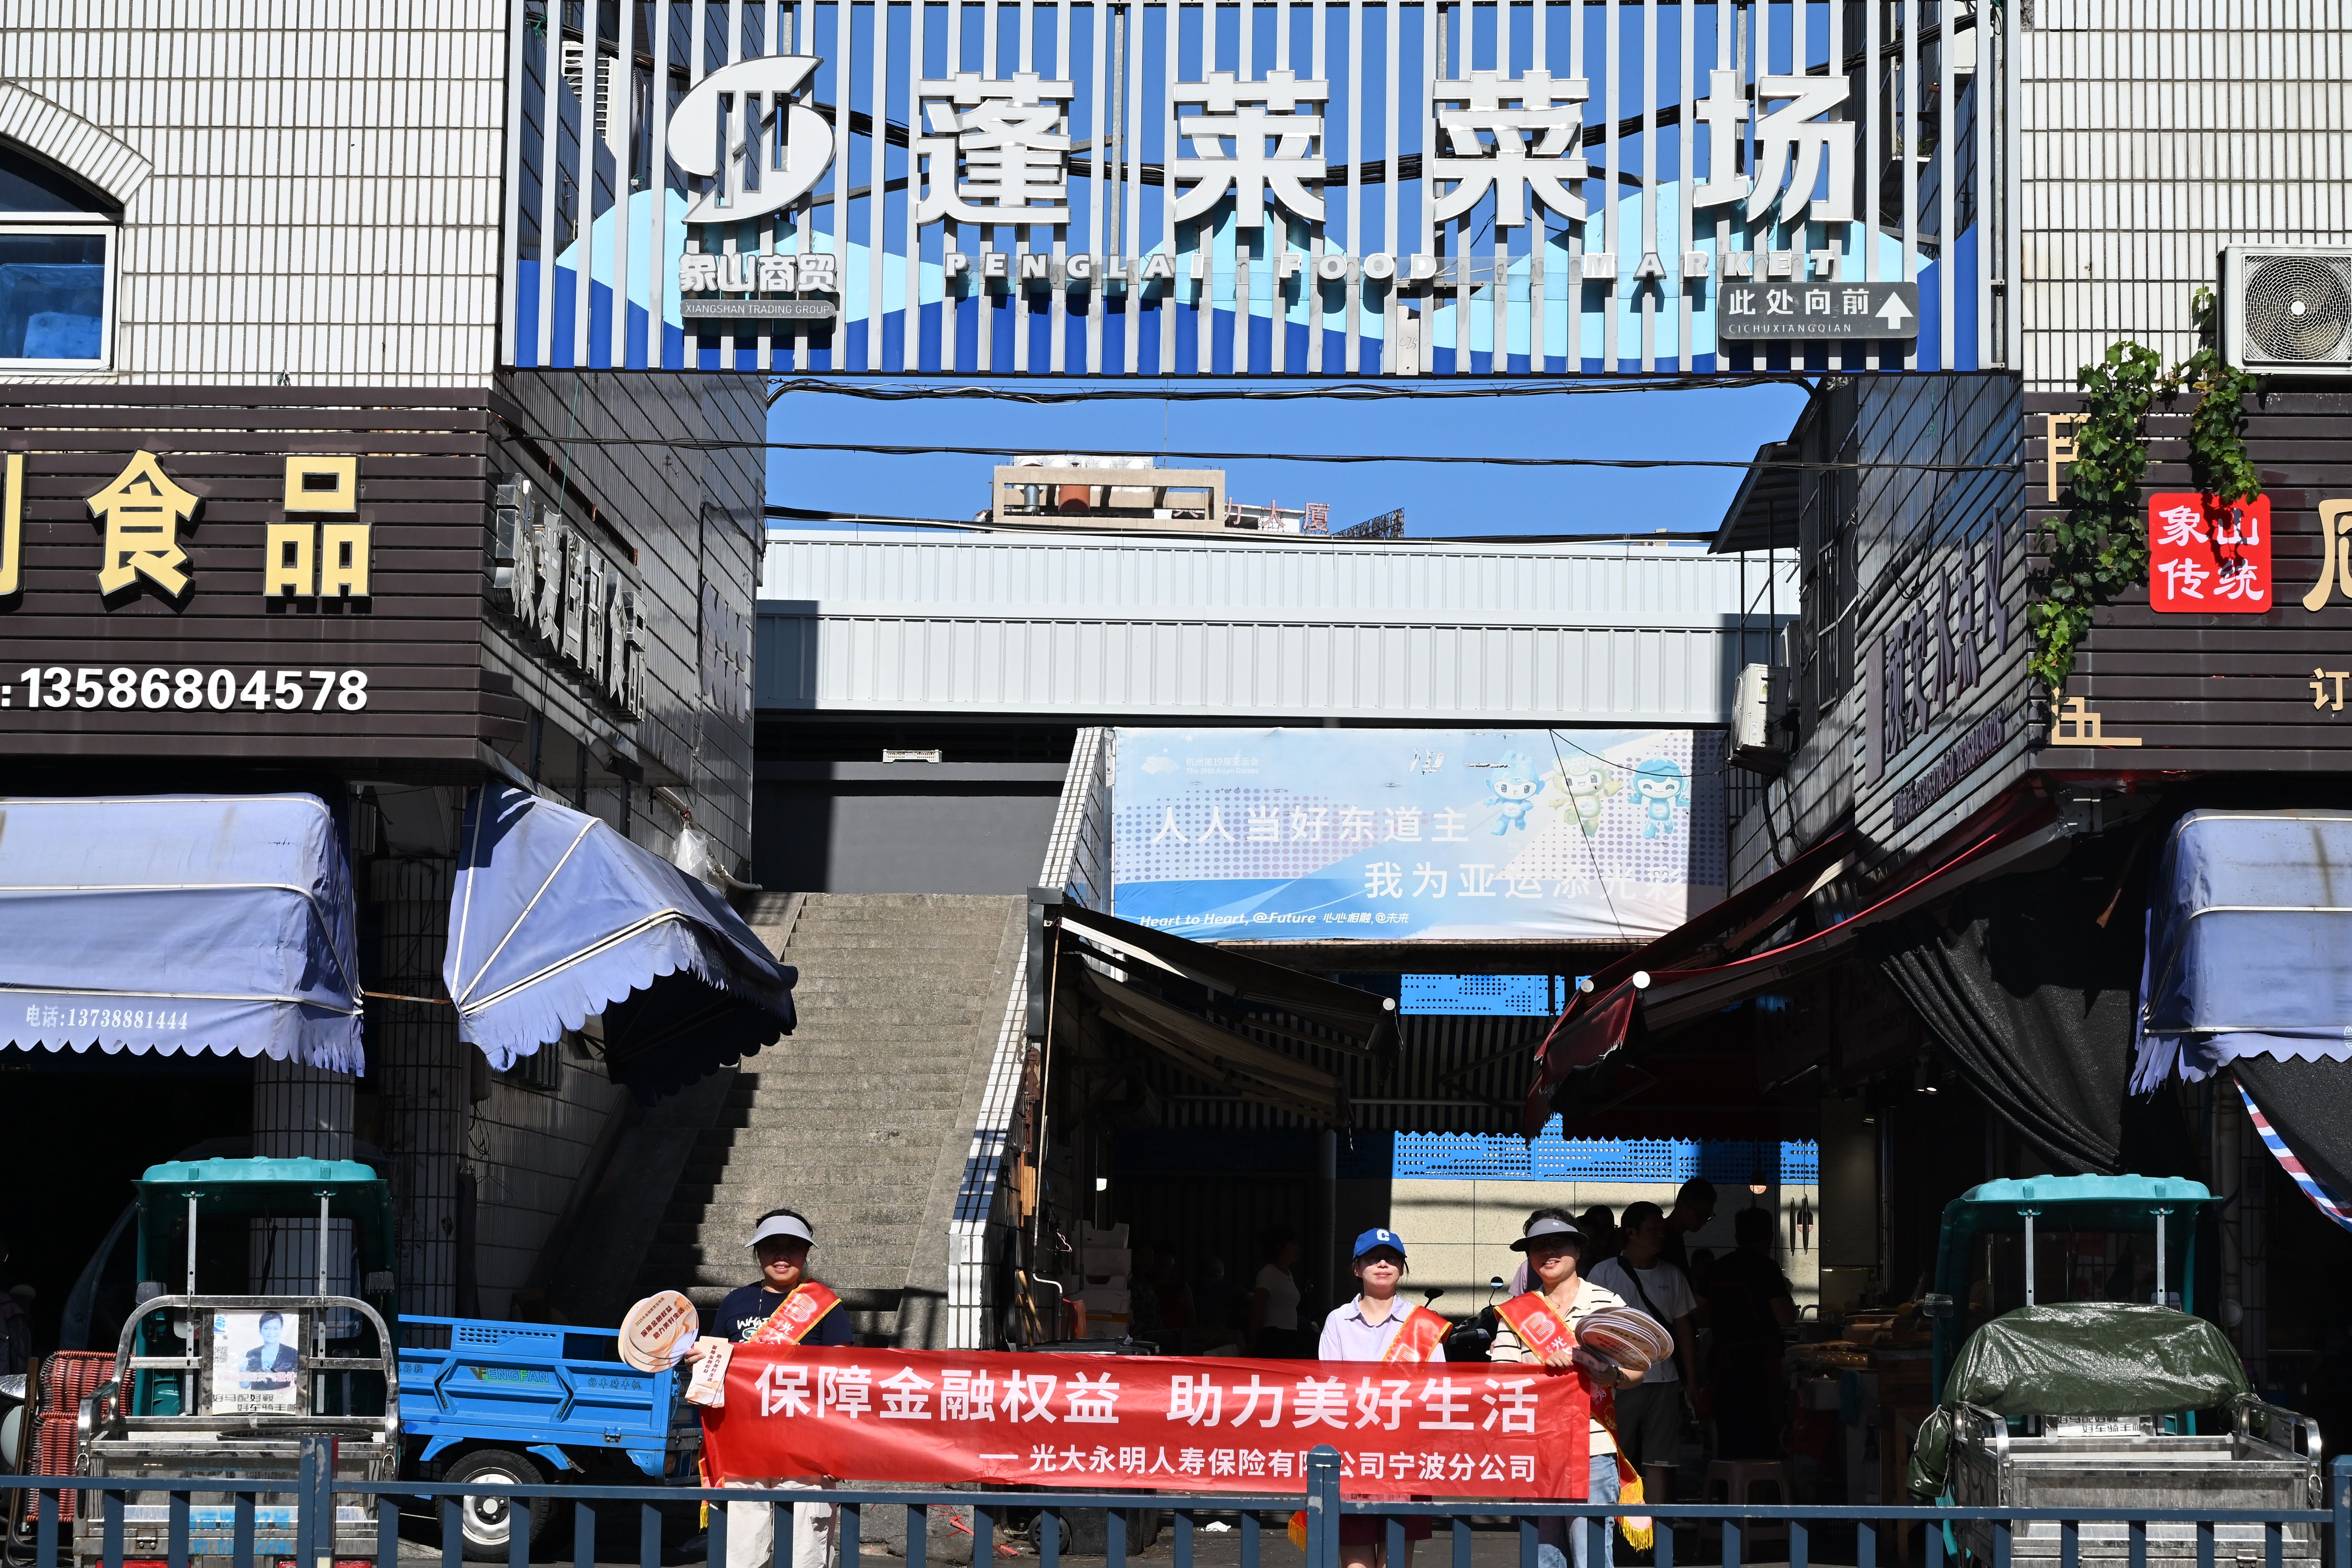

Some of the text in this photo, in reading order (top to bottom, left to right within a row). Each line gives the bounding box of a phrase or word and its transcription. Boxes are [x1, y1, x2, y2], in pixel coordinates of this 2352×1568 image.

[917, 70, 1855, 228] 蓬莱菜场
[679, 253, 837, 294] 象山商贸
[945, 250, 1835, 281] PENGLAI FOOD MARKET
[686, 304, 830, 314] XIANGSHAN TRADING GROUP
[1729, 288, 1869, 316] 此处向前
[1729, 324, 1852, 334] CICHUXIANGQIAN
[0, 447, 372, 599] 食品
[2158, 504, 2260, 546] 象山
[2158, 558, 2264, 600] 传统
[2310, 668, 2349, 710] 订
[1186, 758, 1258, 766] 杭州第19届亚运会
[1151, 805, 1469, 844] 人人当好东道主
[1364, 861, 1684, 903] 我为亚运添光彩
[1140, 915, 1180, 927] Heart
[1186, 915, 1200, 925] to
[1204, 913, 1249, 926] Heart,
[1253, 912, 1316, 924] @Future
[26, 1004, 188, 1030] 电话:13738881444
[1376, 1229, 1390, 1241] C
[213, 1393, 274, 1402] 好马配好鞍
[754, 1363, 1537, 1433] 保障金融权益 助力美好生活
